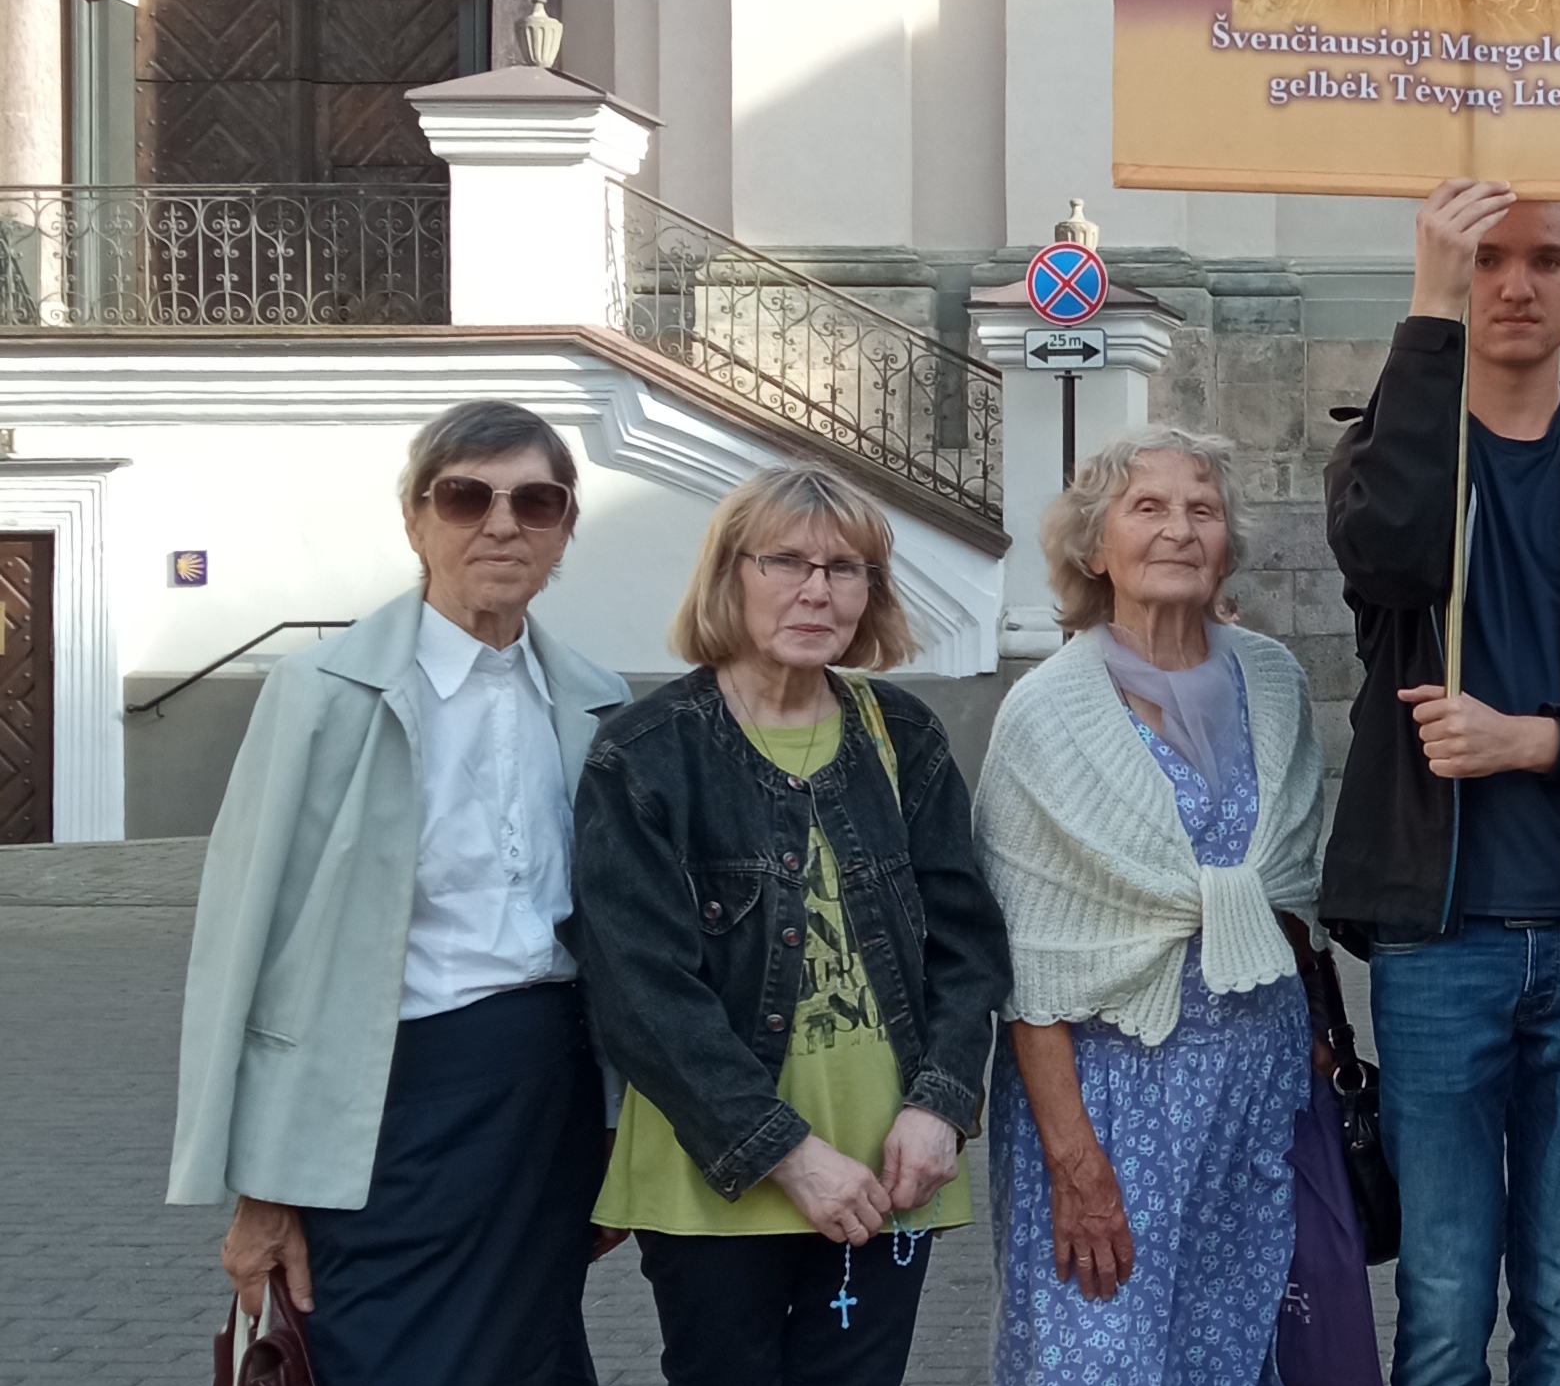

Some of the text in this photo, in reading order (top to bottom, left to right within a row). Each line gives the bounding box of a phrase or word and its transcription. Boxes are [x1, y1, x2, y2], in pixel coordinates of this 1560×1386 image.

[1212, 13, 1432, 66] Švenčiausioji
[1269, 70, 1379, 105] gelbėk
[1389, 74, 1503, 114] Tėvynę
[1049, 333, 1081, 347] 25 m
